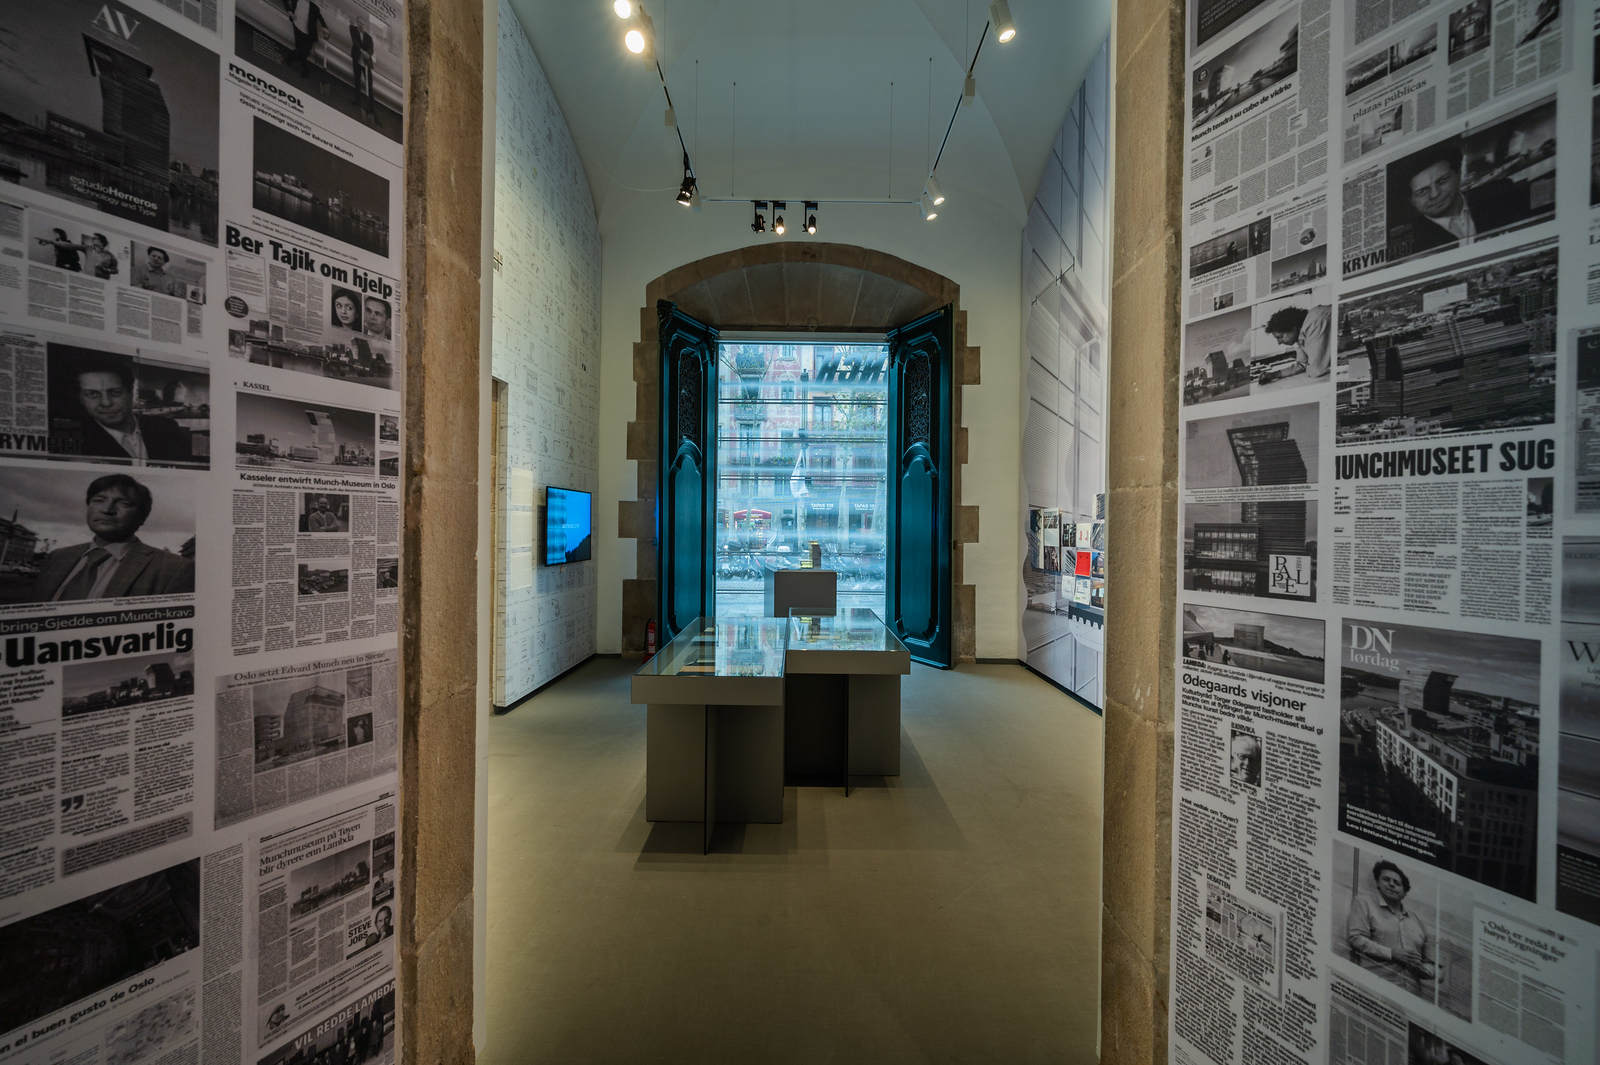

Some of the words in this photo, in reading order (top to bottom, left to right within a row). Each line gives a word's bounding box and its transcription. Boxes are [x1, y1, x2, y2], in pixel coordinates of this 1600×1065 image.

[1191, 128, 1212, 142] Munch
[1242, 99, 1259, 115] cubo
[1260, 94, 1270, 105] de
[1270, 81, 1292, 99] vidrio
[1352, 101, 1382, 122] plazas
[226, 225, 264, 255] Ber
[269, 240, 315, 273] Tajik
[320, 262, 348, 283] om
[352, 269, 393, 300] hjelp
[243, 381, 271, 392] KASSEL
[240, 473, 276, 484] Kasseler
[278, 475, 312, 486] entwirft
[313, 477, 372, 489] Munch-Museum
[381, 480, 396, 490] Oslo
[0, 616, 93, 632] bring-Gjedde
[96, 614, 117, 624] om
[120, 608, 193, 623] Munch-krav:
[5, 622, 194, 668] Uansvarlig
[1349, 624, 1396, 654] DN
[234, 671, 257, 682] Oslo
[258, 667, 280, 679] setzt
[281, 663, 311, 676] Edvard
[312, 658, 340, 671] Munch
[1350, 647, 1400, 671] lørdag
[1182, 673, 1247, 698] Ødegaards
[1251, 688, 1307, 712] visjoner
[1213, 694, 1230, 705] Torger
[1232, 699, 1261, 711] Ødegaard
[1182, 700, 1204, 711] Munchs
[1203, 704, 1220, 714] kunst
[1253, 711, 1300, 729] Munch-museet
[1300, 723, 1315, 733] skal
[259, 836, 326, 867] Munchmuseum
[276, 855, 304, 872] dyrere
[305, 849, 322, 860] enn
[323, 835, 354, 852] Lambda
[1206, 873, 1231, 890] DEBATTEN
[348, 919, 372, 938] STEVE
[1487, 919, 1510, 936] Oslo
[348, 932, 369, 948] JOBS
[15, 1035, 28, 1047] el
[32, 1018, 66, 1039] buen
[70, 999, 106, 1024] gusto
[110, 990, 125, 1003] de
[128, 976, 155, 993] Oslo
[294, 1033, 313, 1051] VIL
[316, 1007, 353, 1037] REDDE
[355, 981, 396, 1013] LAMBDA
